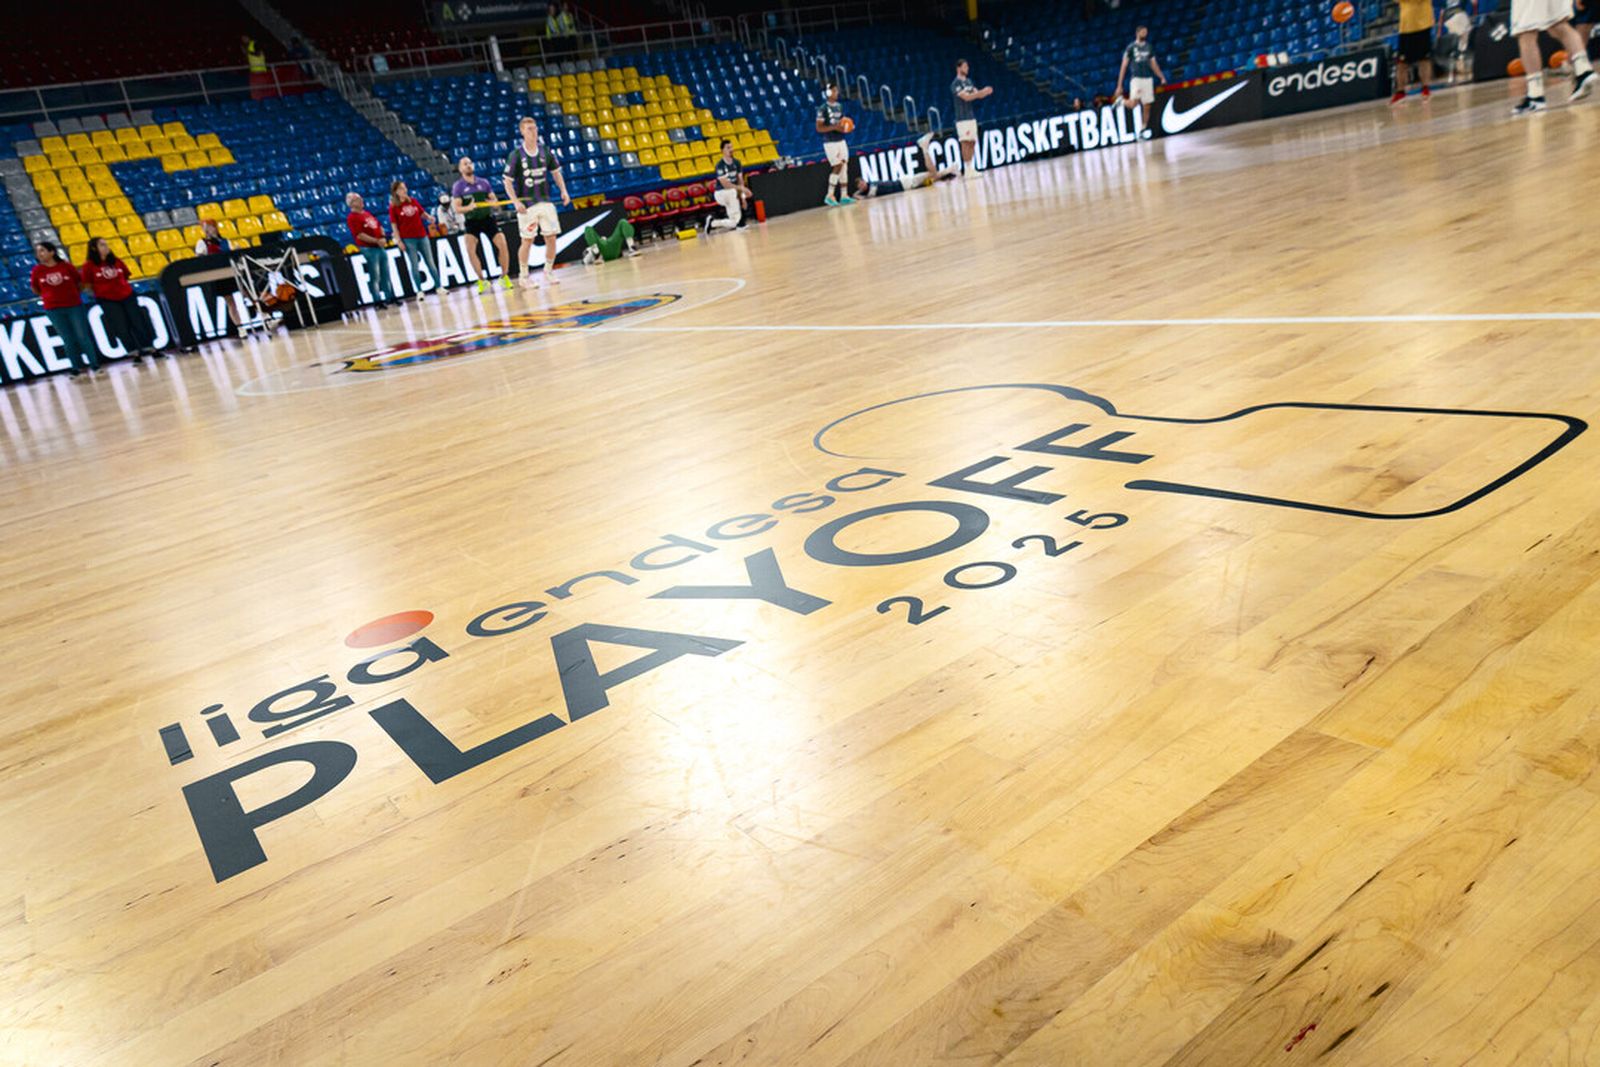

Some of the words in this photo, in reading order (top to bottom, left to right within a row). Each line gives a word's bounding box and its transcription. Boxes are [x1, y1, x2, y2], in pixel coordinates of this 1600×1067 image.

[1268, 57, 1378, 96] endesa
[159, 637, 450, 766] liga
[466, 466, 905, 637] endesa
[182, 423, 1155, 883] PLAYOFF
[877, 509, 1130, 626] 2025
